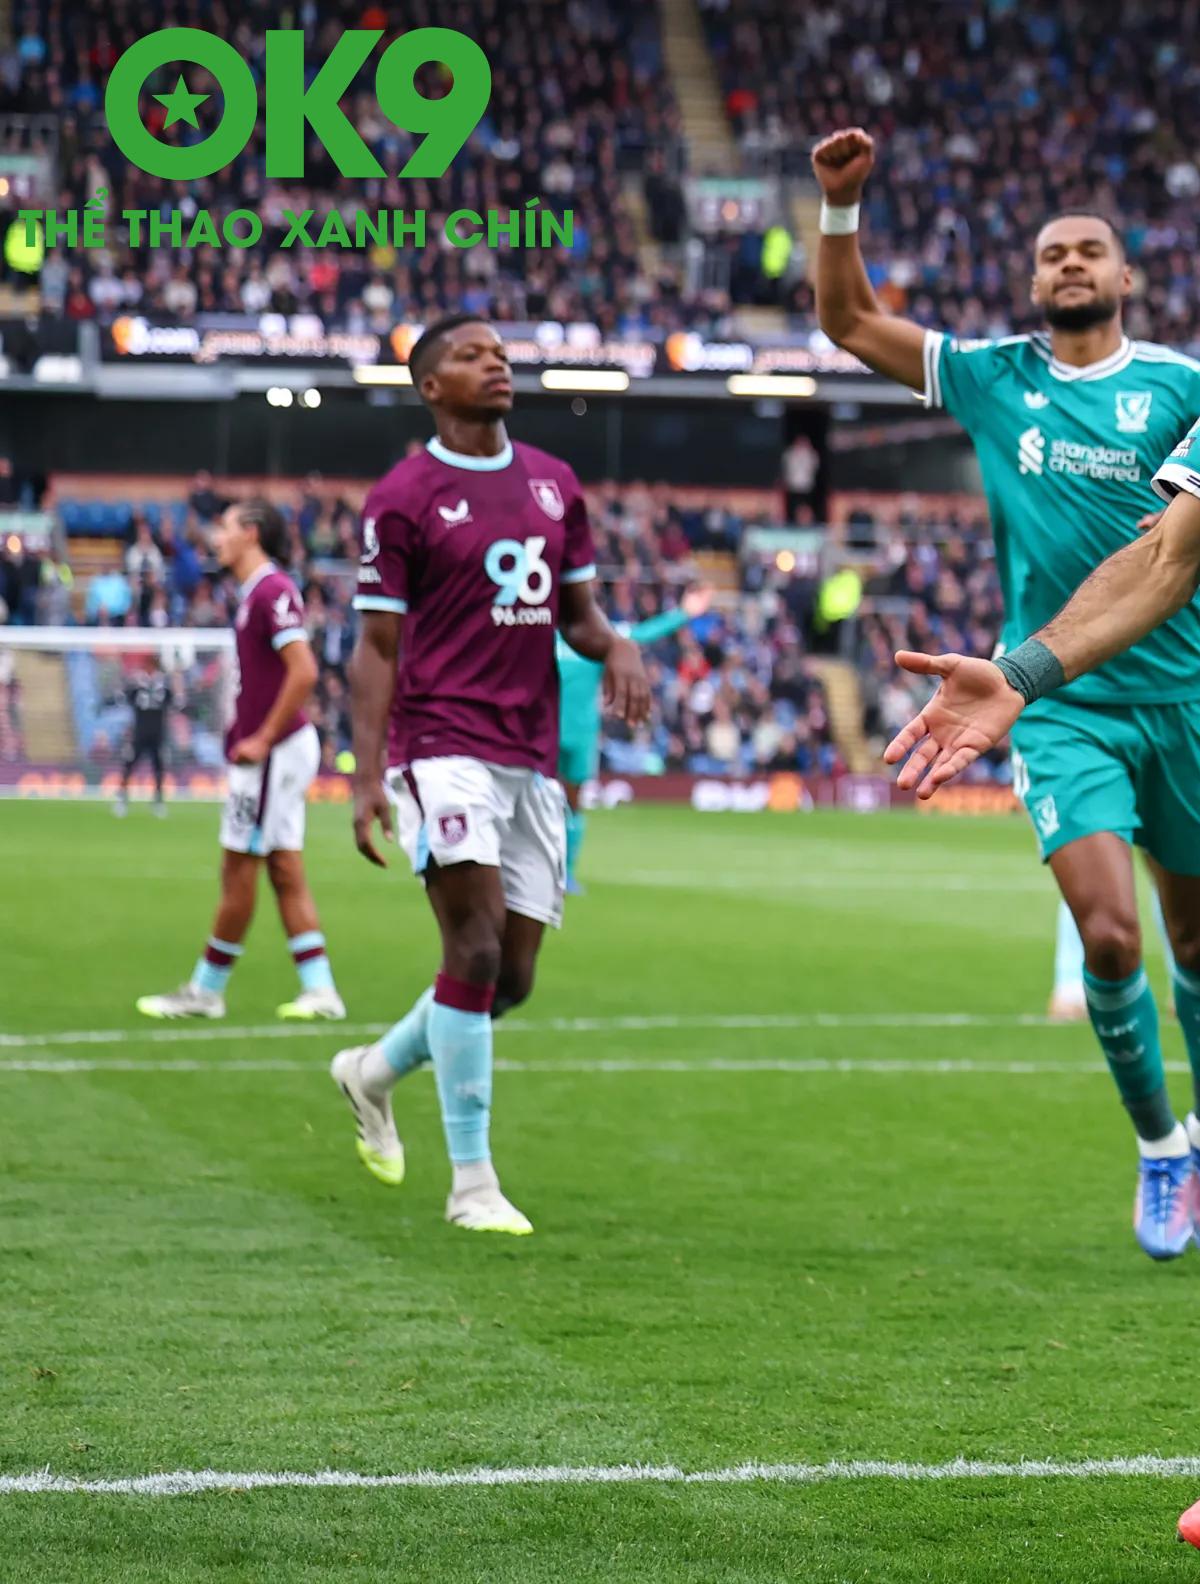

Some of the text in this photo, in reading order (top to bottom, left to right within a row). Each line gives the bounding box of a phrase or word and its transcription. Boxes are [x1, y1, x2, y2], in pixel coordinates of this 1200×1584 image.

[1051, 440, 1137, 466] standard
[1048, 456, 1141, 482] chartered
[484, 535, 552, 606] 96
[491, 606, 552, 627] 96.com
